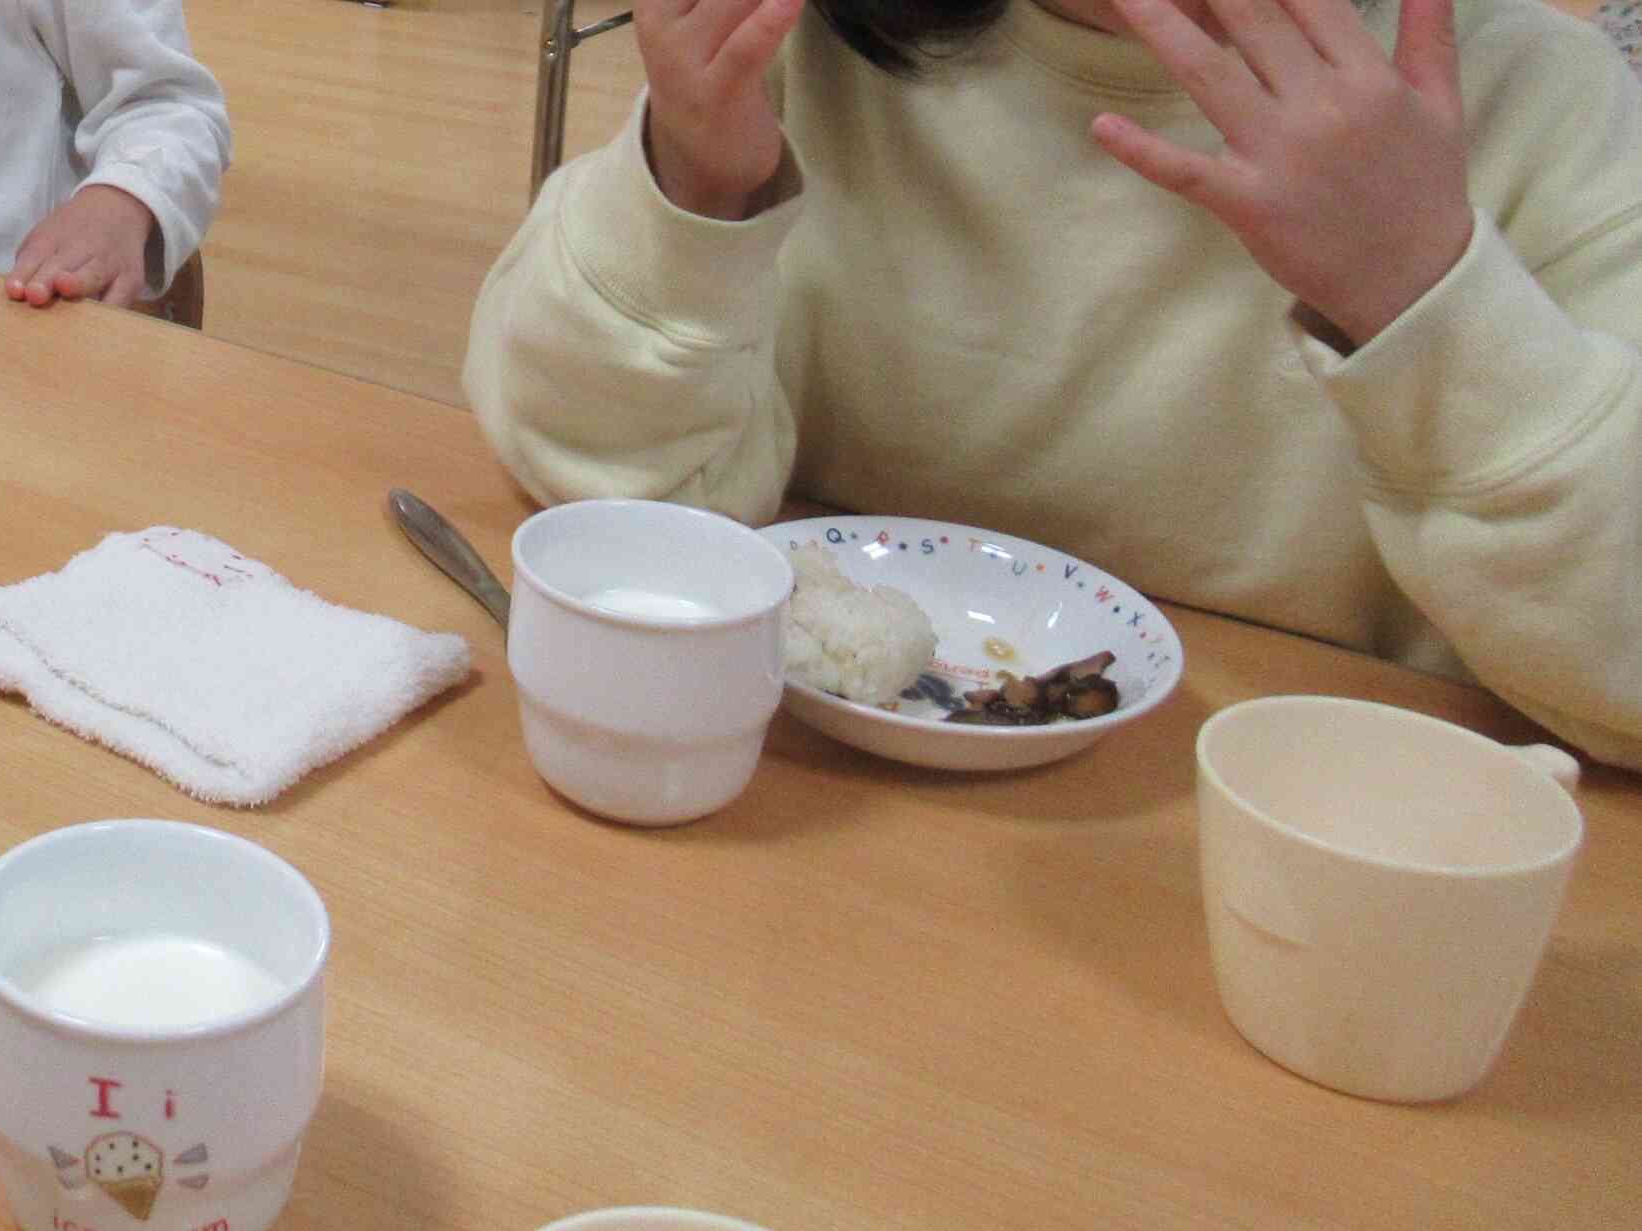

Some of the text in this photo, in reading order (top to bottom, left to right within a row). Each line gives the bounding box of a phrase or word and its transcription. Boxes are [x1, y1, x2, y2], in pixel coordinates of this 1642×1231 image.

[826, 527, 846, 544] Q
[921, 538, 935, 555] S
[1064, 563, 1079, 579] V
[88, 1076, 176, 1120] I i
